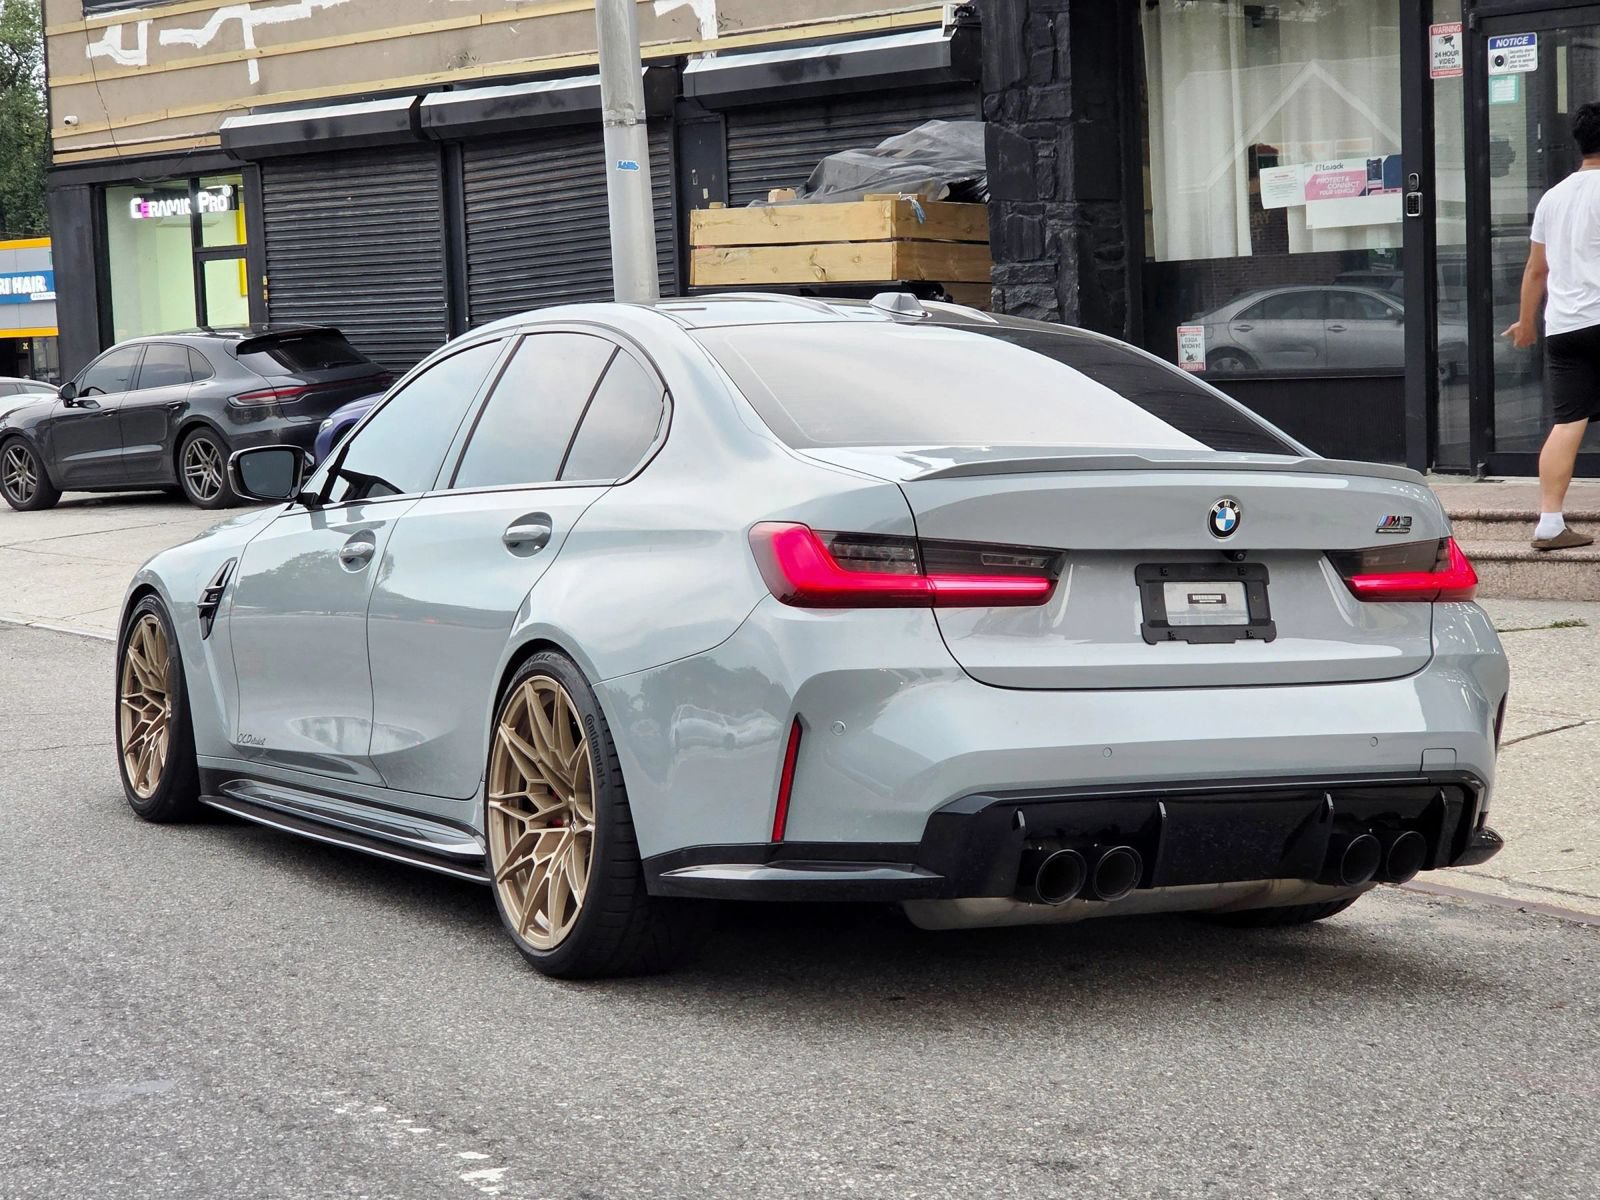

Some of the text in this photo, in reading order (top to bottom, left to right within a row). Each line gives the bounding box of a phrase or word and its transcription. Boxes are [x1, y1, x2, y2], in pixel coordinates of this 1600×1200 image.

[1496, 36, 1529, 48] NOTICE
[1442, 49, 1459, 57] HOUR
[1438, 57, 1456, 65] VIDEO
[12, 275, 47, 294] HAIR
[1213, 499, 1240, 514] BMW
[1382, 515, 1412, 527] M3
